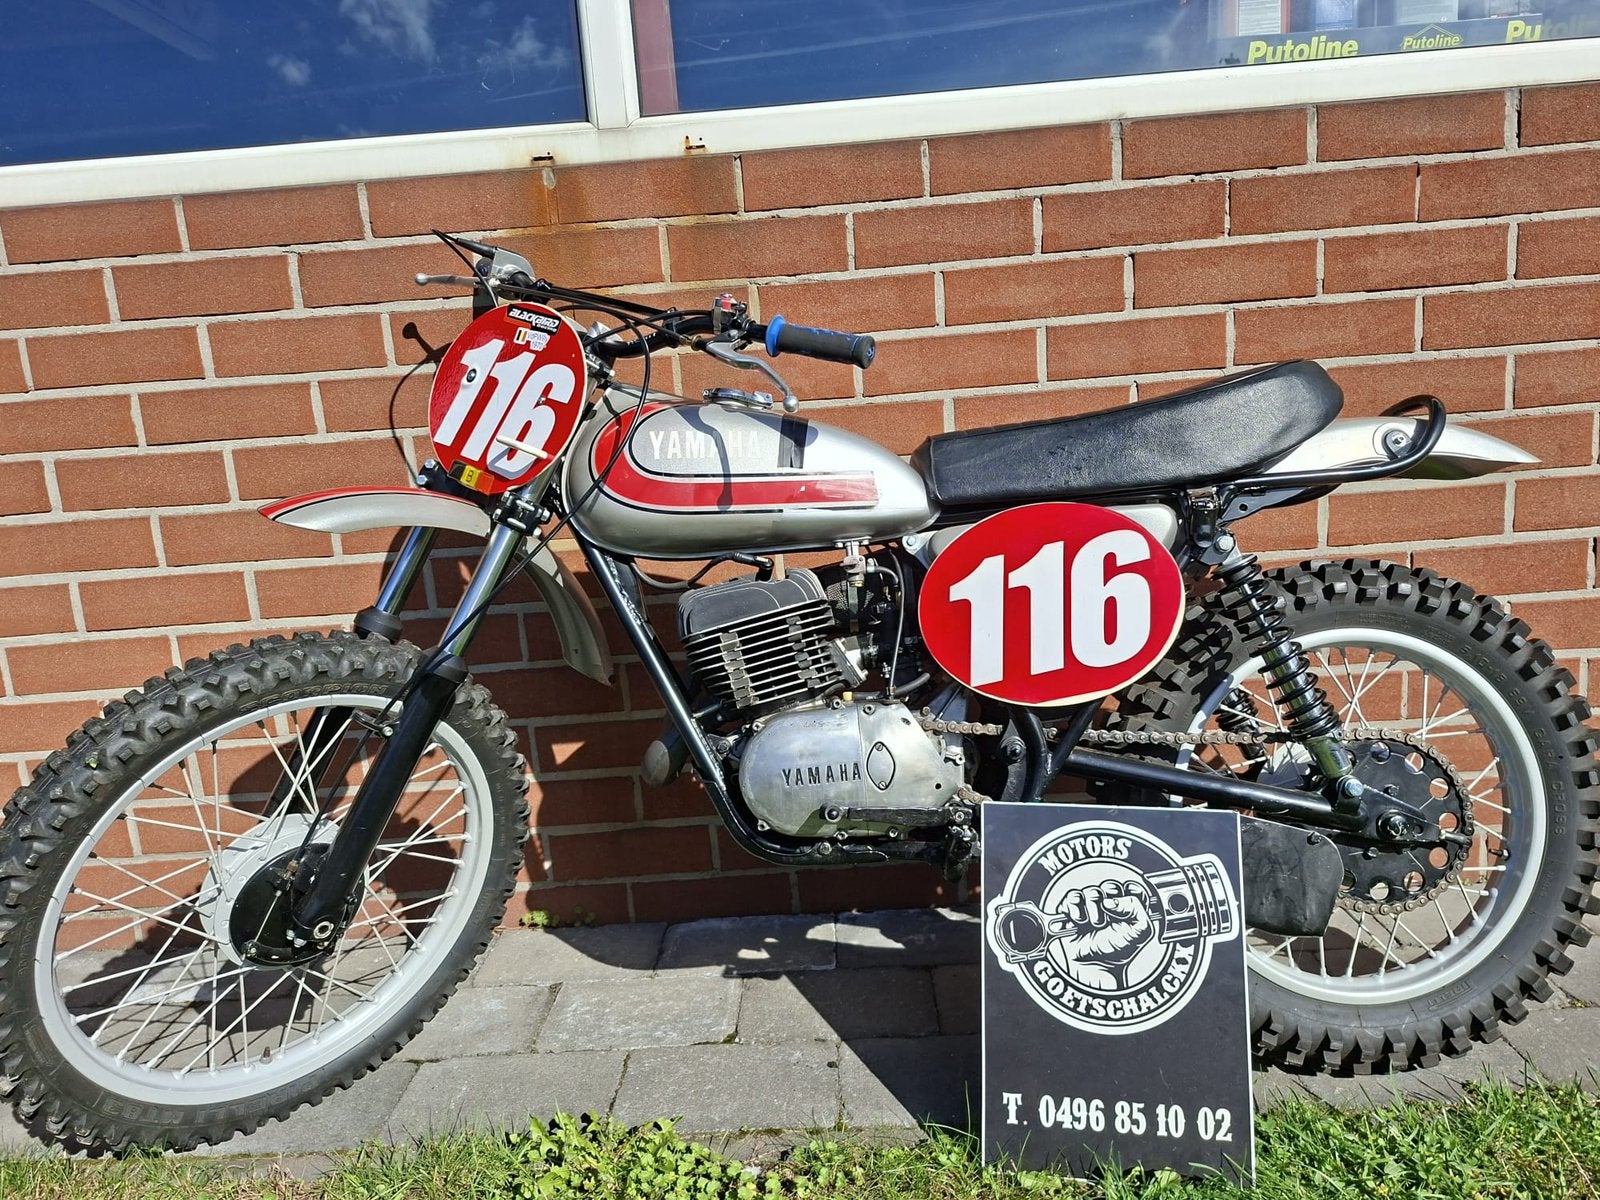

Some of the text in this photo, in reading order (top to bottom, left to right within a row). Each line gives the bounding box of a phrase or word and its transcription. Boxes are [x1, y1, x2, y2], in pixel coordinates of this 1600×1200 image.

[1247, 35, 1359, 64] Putoline
[1403, 34, 1460, 51] Putoline
[433, 338, 576, 480] 116
[649, 430, 758, 460] YAMAHA
[949, 529, 1151, 687] 116
[781, 762, 862, 788] YAMAHA
[1038, 835, 1132, 877] MOTORS
[1033, 943, 1195, 1019] GOETSCHALCKX
[1002, 1092, 1233, 1142] T. 0496 85 10 02
